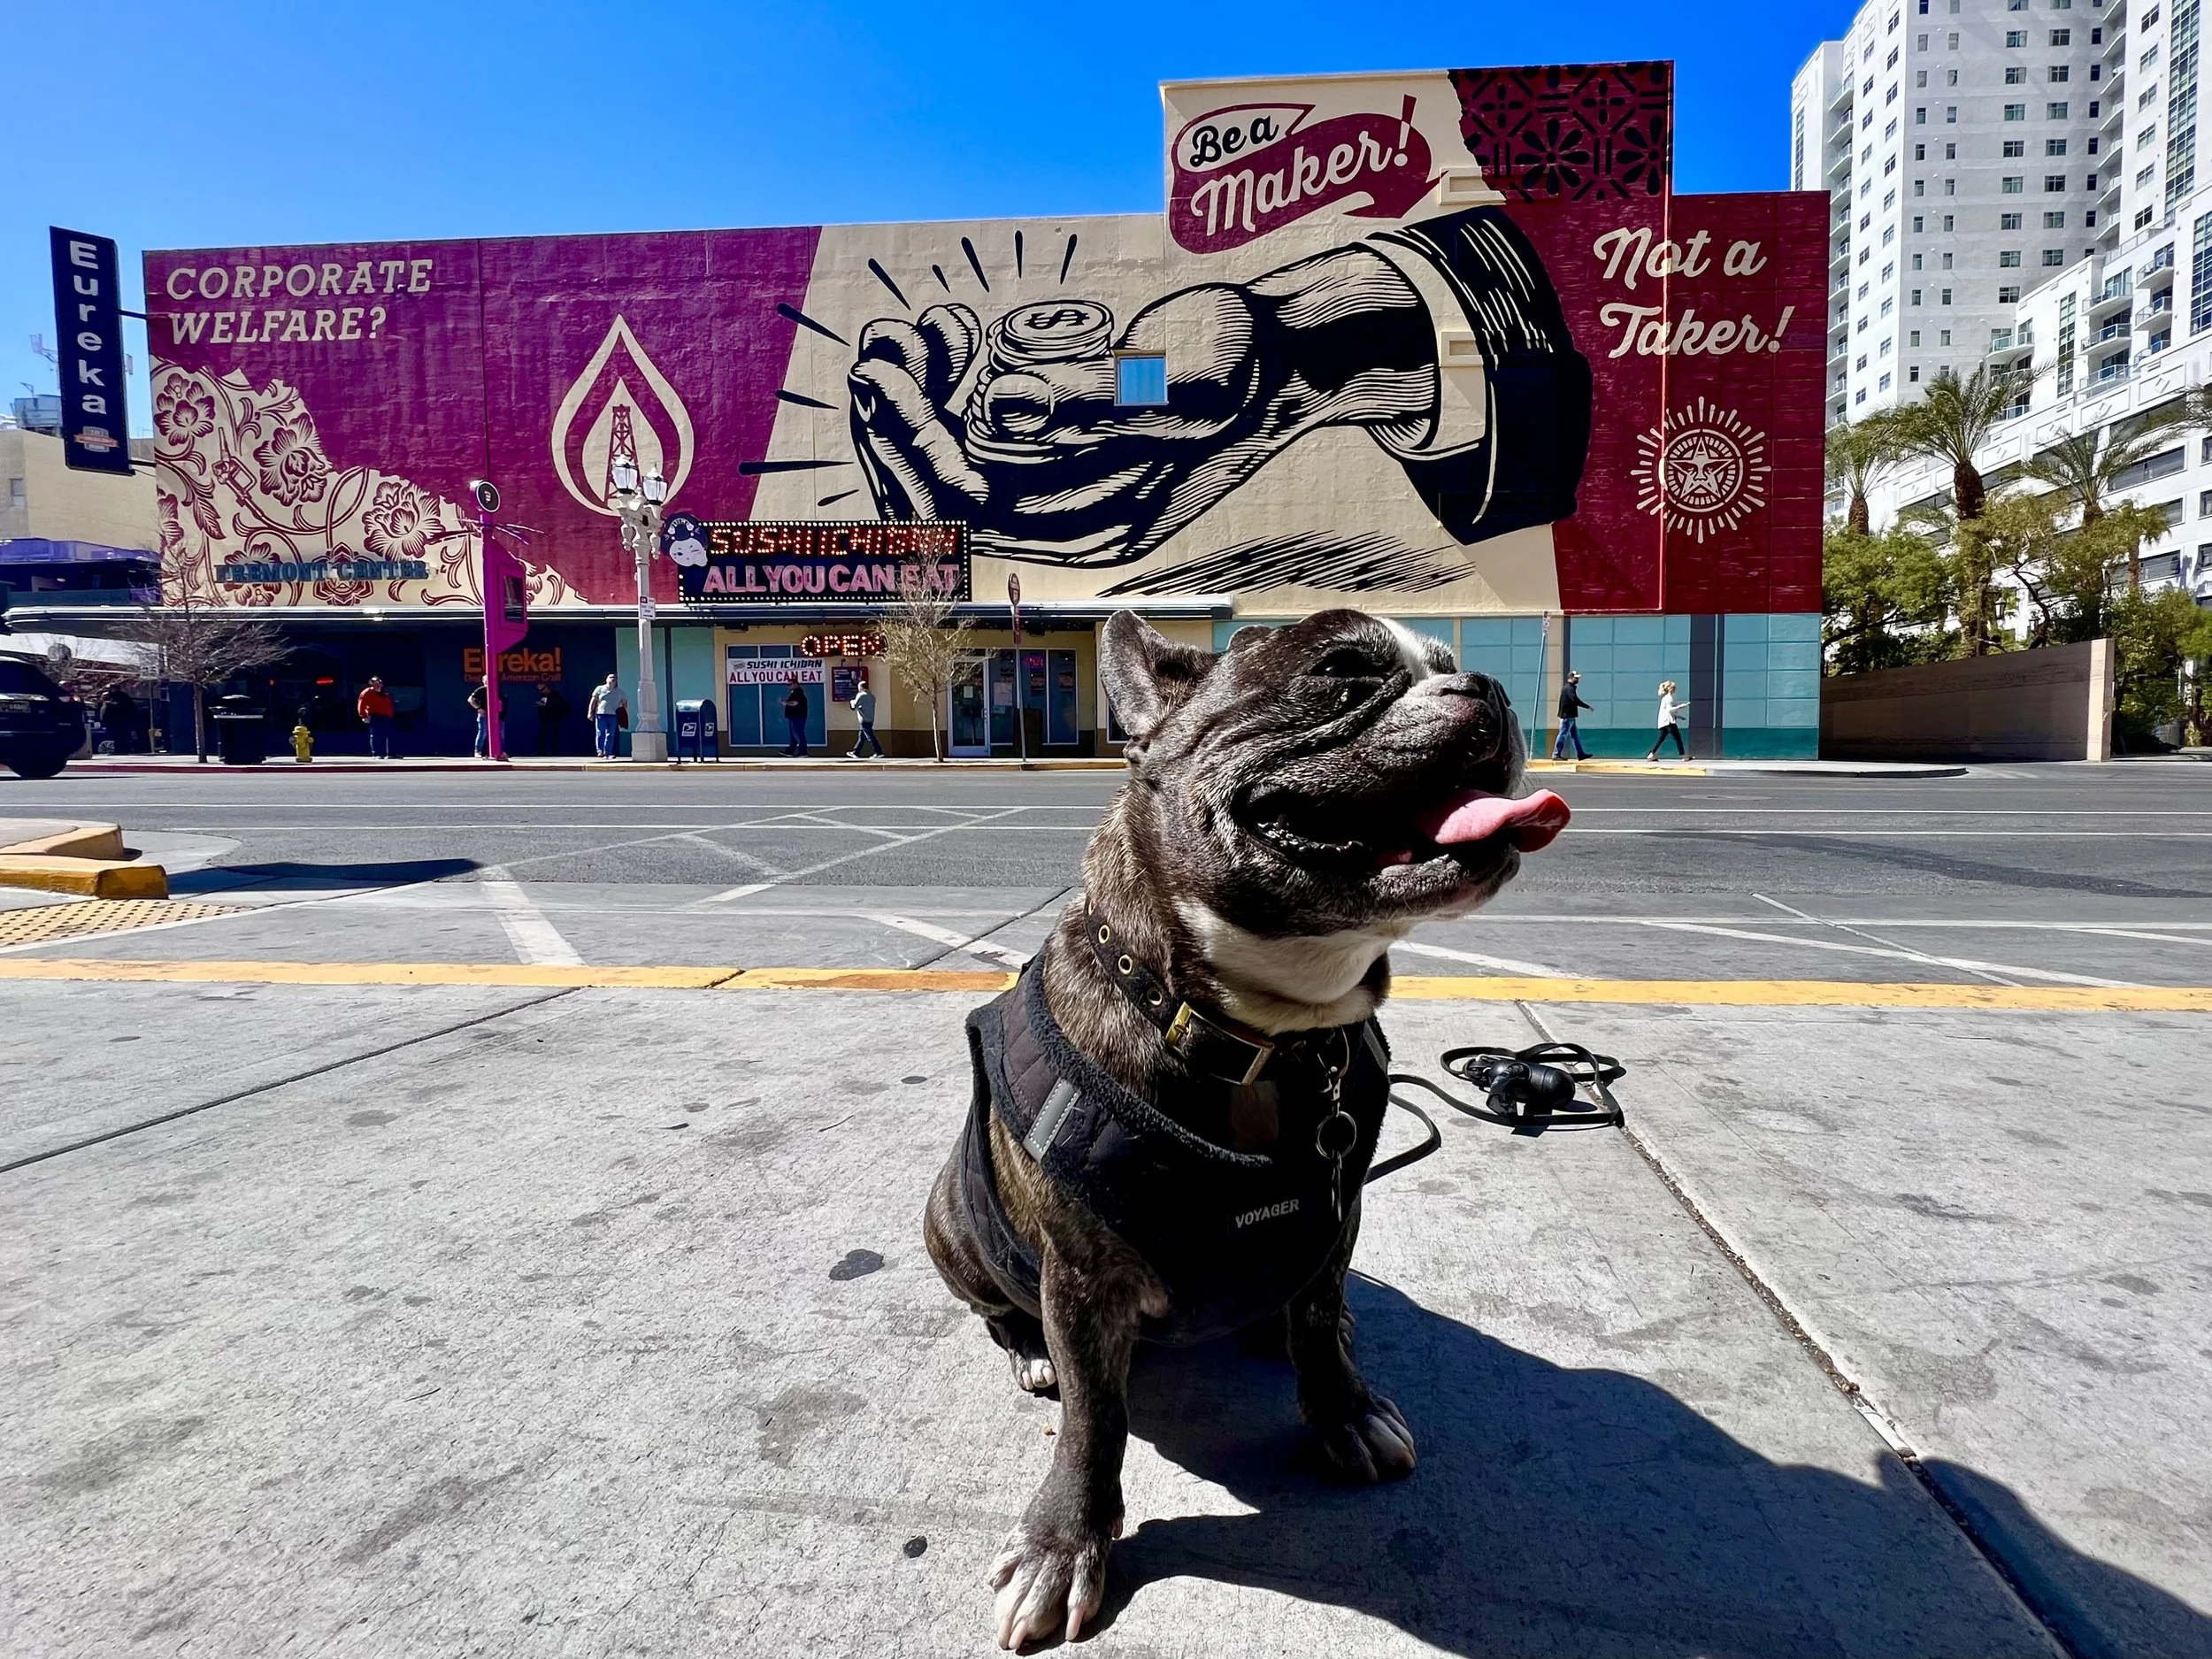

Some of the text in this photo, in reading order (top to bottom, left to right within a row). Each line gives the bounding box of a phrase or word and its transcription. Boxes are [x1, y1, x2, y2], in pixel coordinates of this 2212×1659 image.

[1189, 115, 1279, 167] Be a
[1190, 94, 1417, 237] Maker!
[1593, 227, 1768, 290] Not a
[166, 259, 433, 300] CORPORATE
[69, 240, 107, 415] Eureka
[168, 306, 387, 344] WELFARE?
[1599, 303, 1796, 359] Taker!
[710, 526, 813, 556] SUSHI
[214, 561, 430, 583] FREMONT CENTER
[703, 564, 960, 594] ALL YOU CAN EAT
[464, 647, 561, 672] Ereka!
[800, 633, 882, 657] OPEN
[729, 672, 750, 683] ALL
[751, 672, 773, 682] YOU
[802, 671, 822, 681] EAT
[746, 660, 777, 669] SUSHI
[780, 659, 822, 668] ICHIBAN
[1235, 1199, 1299, 1228] VOYAGER
